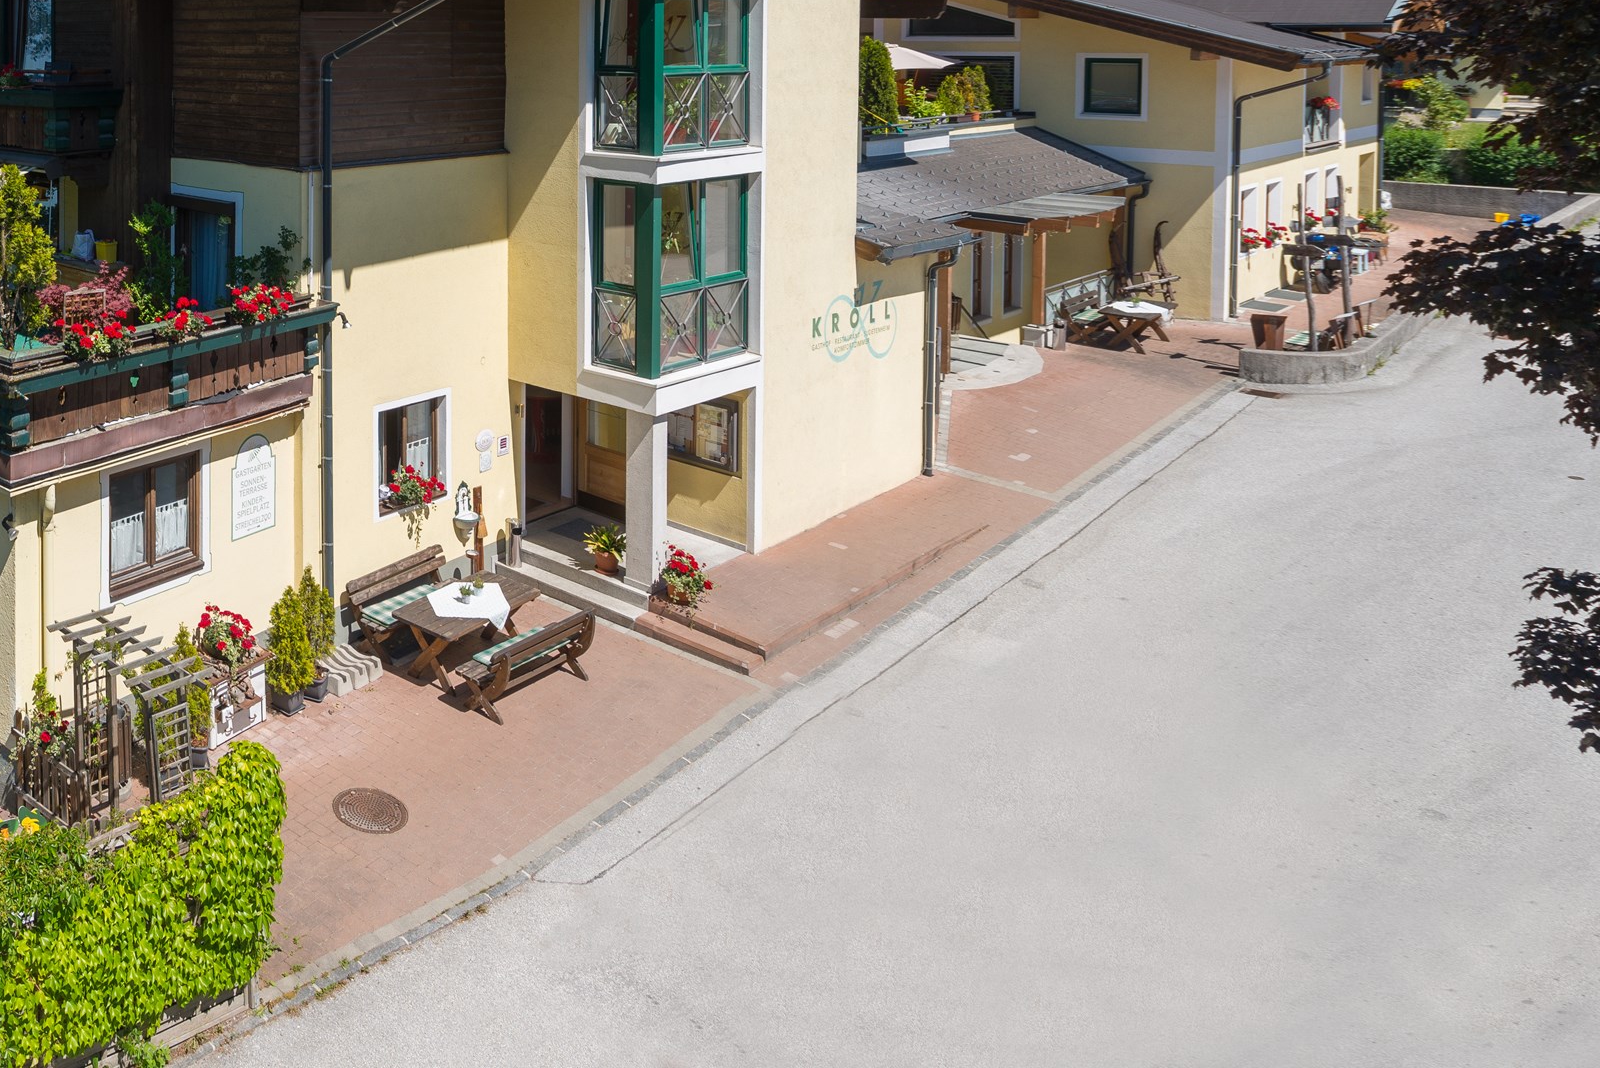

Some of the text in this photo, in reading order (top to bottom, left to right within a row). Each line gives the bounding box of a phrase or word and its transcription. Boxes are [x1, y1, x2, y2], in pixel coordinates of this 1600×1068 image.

[811, 301, 891, 339] KROLL
[811, 340, 831, 351] GASTHOF
[235, 461, 272, 479] GASTGARTEN
[239, 482, 268, 498] TERRASSE
[240, 475, 266, 489] SONNEN-
[241, 495, 265, 509] KINDER-
[236, 502, 270, 519] SPIELPLATZ
[234, 513, 272, 531] STREICHELZOO
